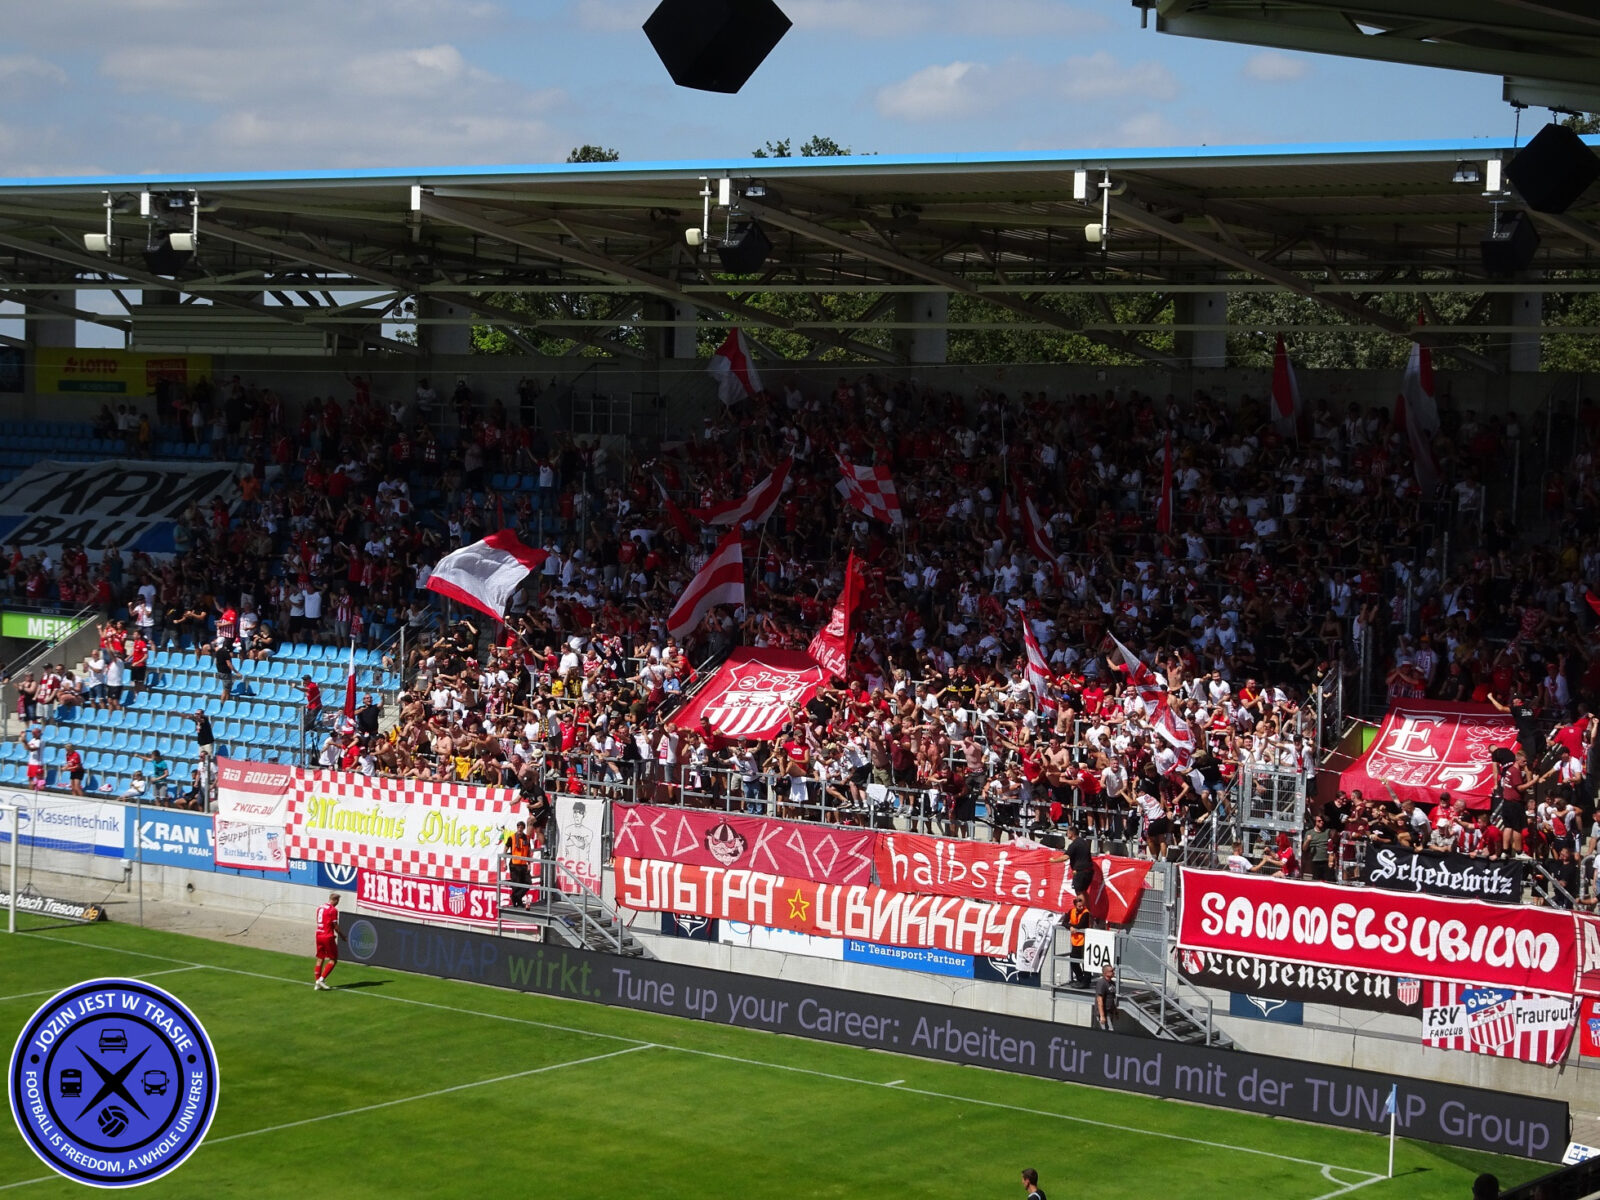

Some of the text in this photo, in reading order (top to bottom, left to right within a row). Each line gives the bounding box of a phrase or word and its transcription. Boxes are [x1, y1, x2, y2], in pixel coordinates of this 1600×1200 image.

[80, 358, 118, 374] LOTTO
[27, 618, 72, 638] MEIN
[37, 807, 120, 832] Kassentechnik
[233, 802, 274, 815] ZWICKAU
[134, 819, 199, 847] KRAN
[306, 795, 407, 839] Mauritius
[418, 809, 494, 848] Oilers
[614, 807, 700, 857] RED
[1370, 849, 1513, 895] Schedewitz
[363, 871, 445, 913] HARTEN
[43, 897, 99, 920] Tresore.de
[816, 883, 1021, 956] ЦВИККАУ
[850, 941, 966, 967] Ihr Teamsport-Partner
[1086, 943, 1111, 967] 19A
[1428, 1006, 1460, 1026] FSV
[1471, 1002, 1507, 1022] FSV
[394, 928, 497, 977] TUNAP
[508, 950, 600, 996] wirkt.
[612, 968, 675, 1007] Tune
[685, 987, 718, 1016] up
[728, 993, 789, 1024] your
[798, 998, 900, 1043] Career:
[911, 1015, 1036, 1066] Arbeiten
[1048, 1036, 1093, 1074] für
[1103, 1053, 1161, 1087] und
[1174, 1061, 1227, 1098] mit
[1237, 1068, 1293, 1107] der
[1304, 1078, 1426, 1128] TUNAP
[1439, 1100, 1550, 1156] Group
[1430, 1027, 1463, 1038] FANCLUB
